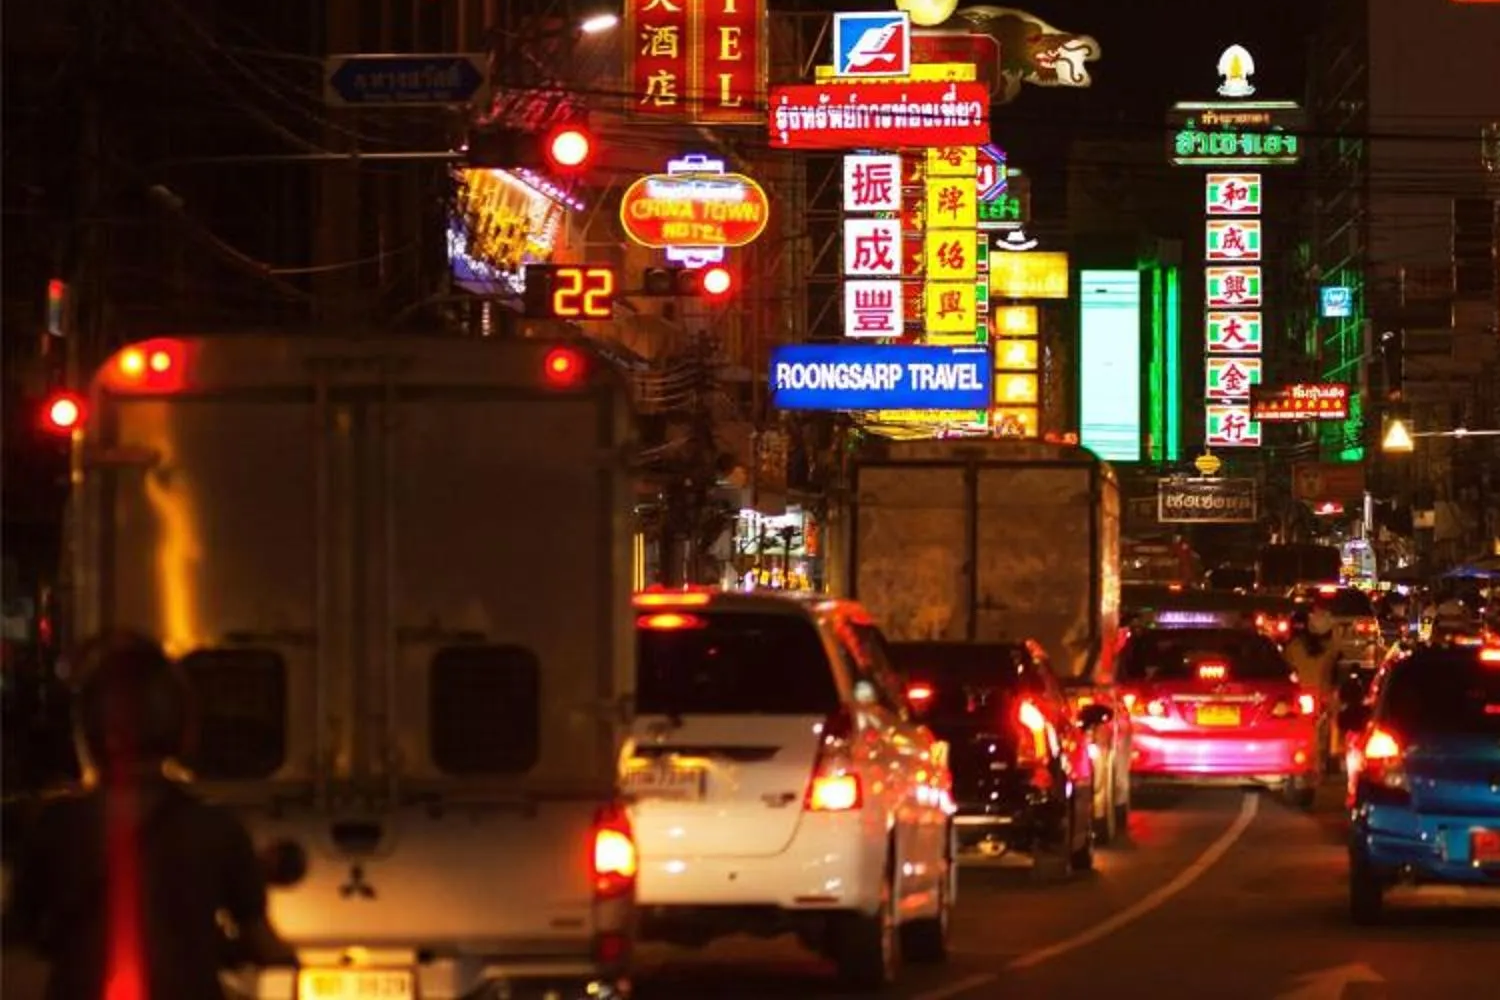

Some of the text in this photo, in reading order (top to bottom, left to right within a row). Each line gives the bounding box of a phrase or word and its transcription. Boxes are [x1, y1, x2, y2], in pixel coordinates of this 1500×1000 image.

[631, 199, 761, 221] CHINA TOWN
[663, 222, 726, 242] HOTEL
[852, 162, 895, 331] 振成豐
[553, 268, 613, 316] 22
[1220, 181, 1248, 439] 和成興大金行
[777, 363, 983, 390] ROONGSARP TRAVEL
